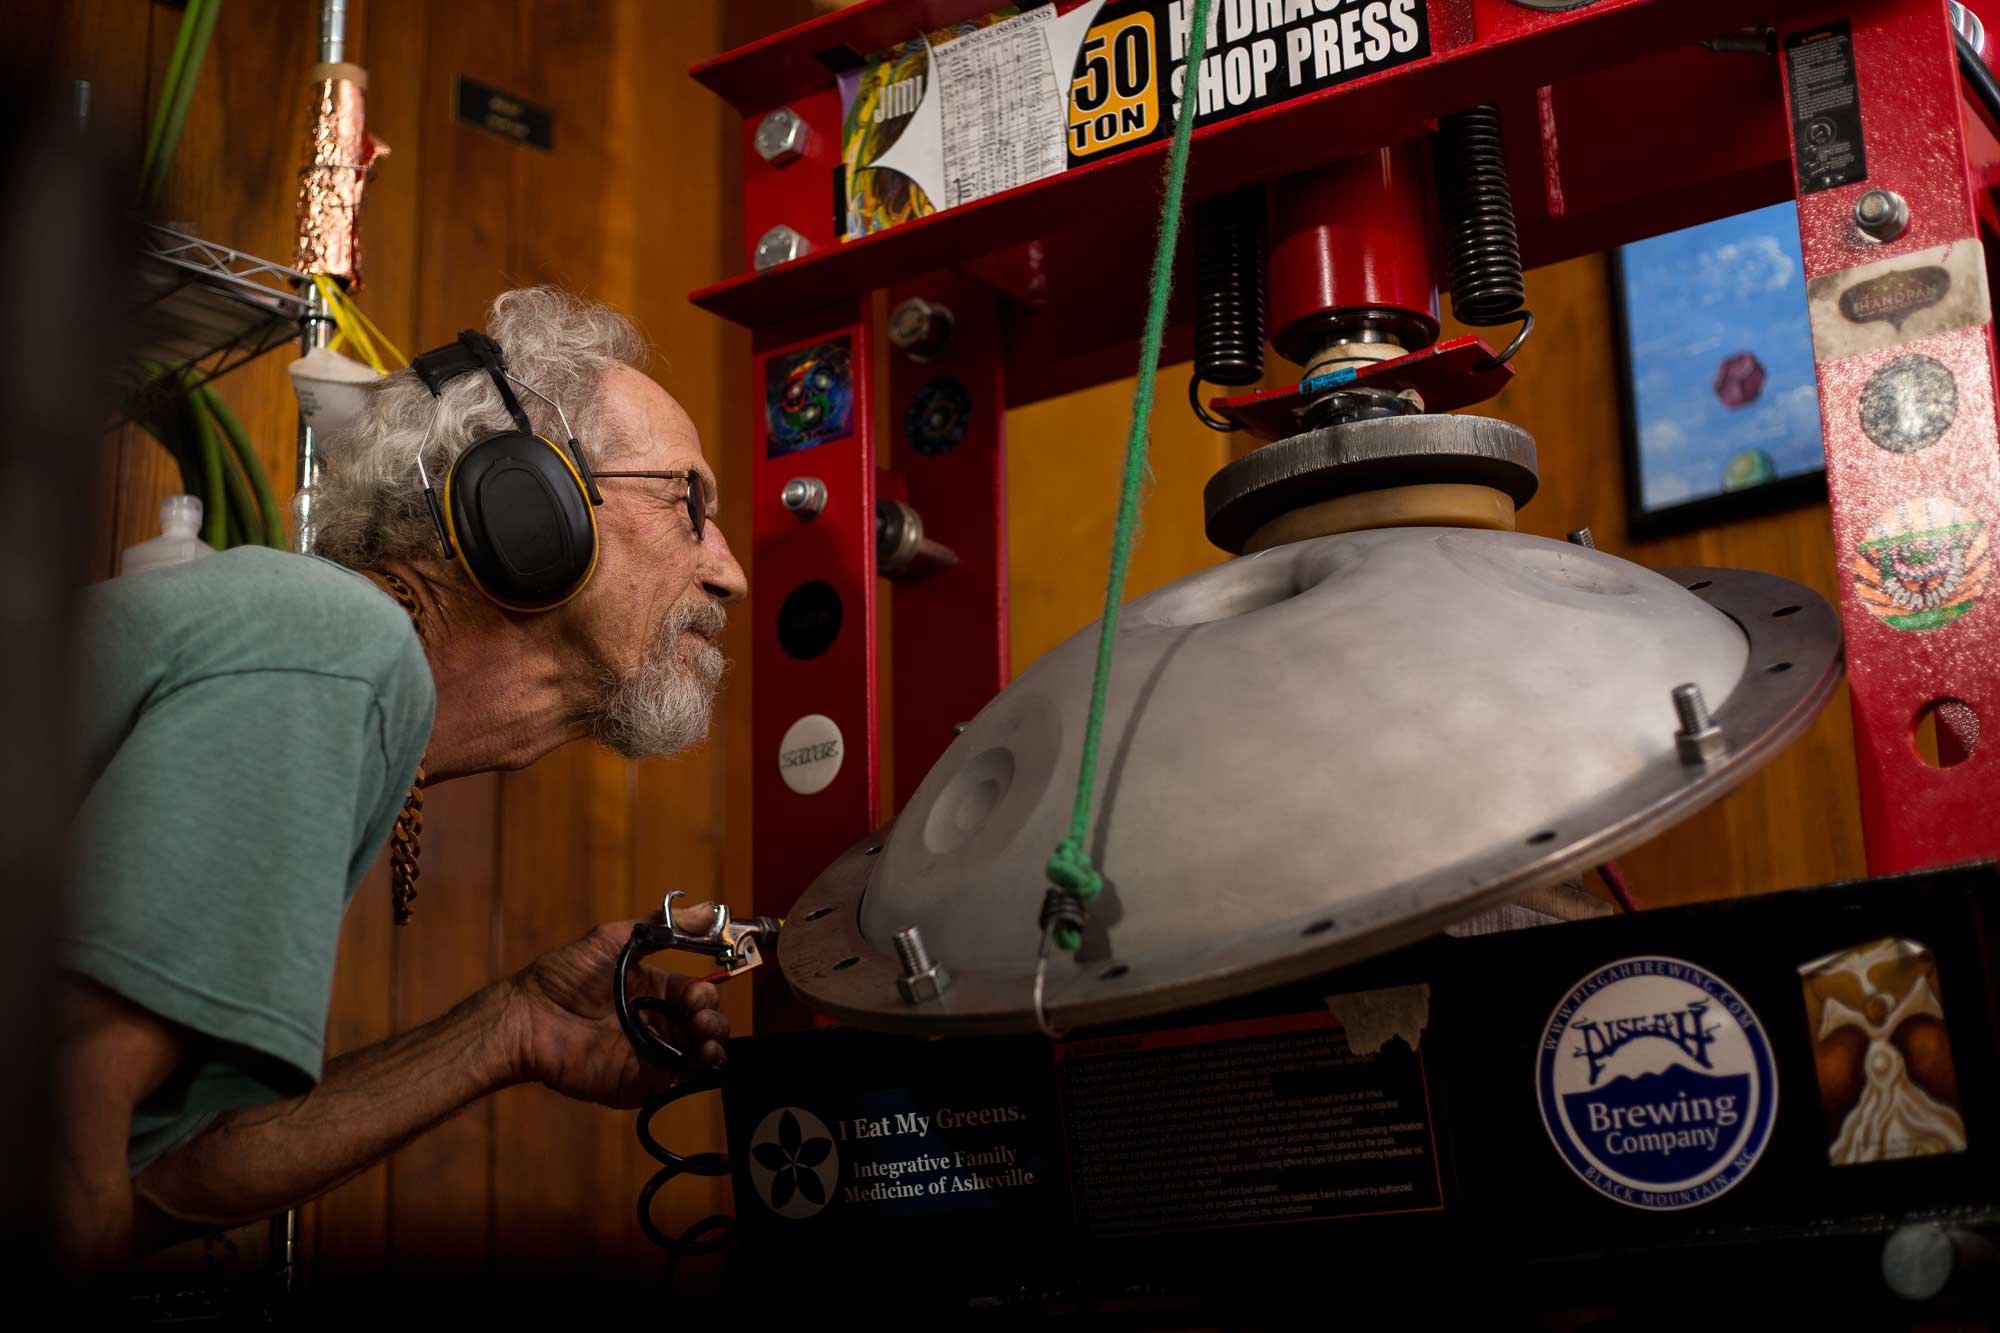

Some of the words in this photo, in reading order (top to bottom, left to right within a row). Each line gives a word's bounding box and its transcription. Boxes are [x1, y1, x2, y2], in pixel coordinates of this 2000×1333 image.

[995, 9, 1052, 34] INSTRUMENTS
[1074, 24, 1151, 112] 50
[1171, 38, 1277, 121] SHOP
[1287, 1, 1418, 88] PRESS
[1070, 102, 1146, 151] TON
[1544, 959, 1753, 1051] WWW.PISGAHBREWING.COM
[1573, 999, 1720, 1084] PISGAH
[839, 1121, 848, 1142] I
[855, 1117, 891, 1139] Eat
[895, 1112, 930, 1137] My
[936, 1104, 1027, 1129] Greens.
[1587, 1092, 1738, 1132] Brewing
[853, 1153, 950, 1179] Integrative
[953, 1147, 1017, 1169] Family
[1605, 1127, 1719, 1156] Company
[843, 1181, 925, 1204] Medicine
[928, 1177, 947, 1195] of
[951, 1167, 1034, 1192] Asheville
[1584, 1166, 1635, 1202] BLACK
[1734, 1147, 1756, 1174] NC
